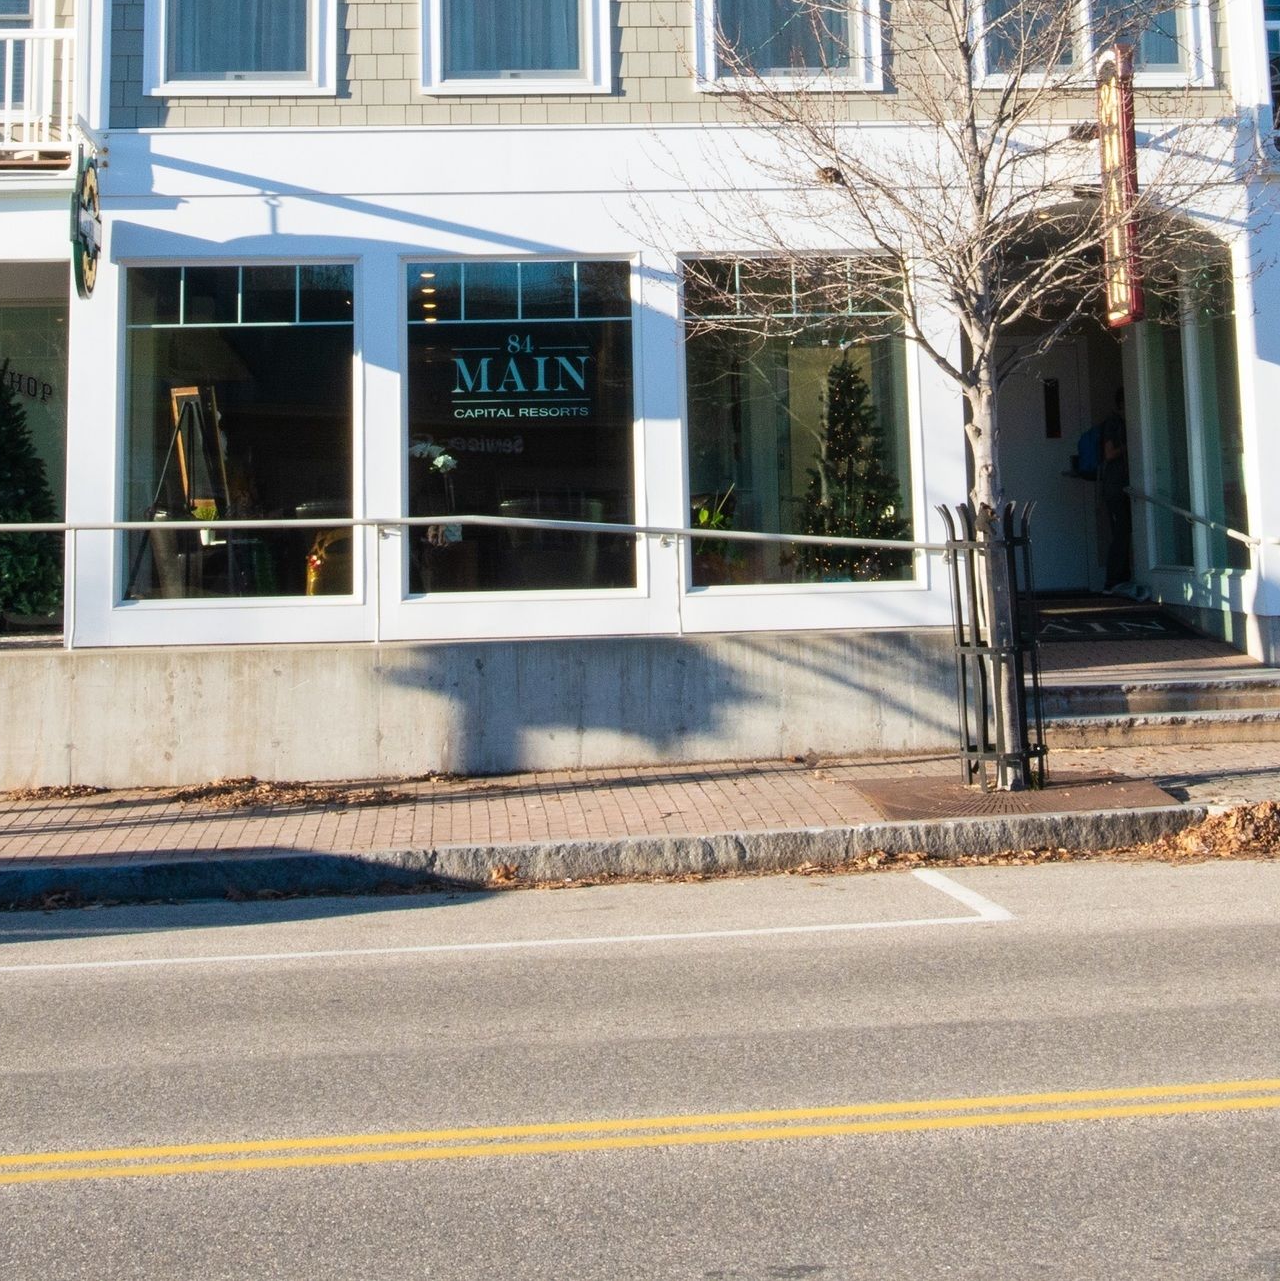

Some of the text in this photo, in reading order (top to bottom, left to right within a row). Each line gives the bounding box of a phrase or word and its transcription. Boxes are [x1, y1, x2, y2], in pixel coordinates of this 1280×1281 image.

[507, 334, 534, 353] 84
[451, 356, 590, 393] MAIN
[454, 407, 589, 418] CAPITAL RESORTS
